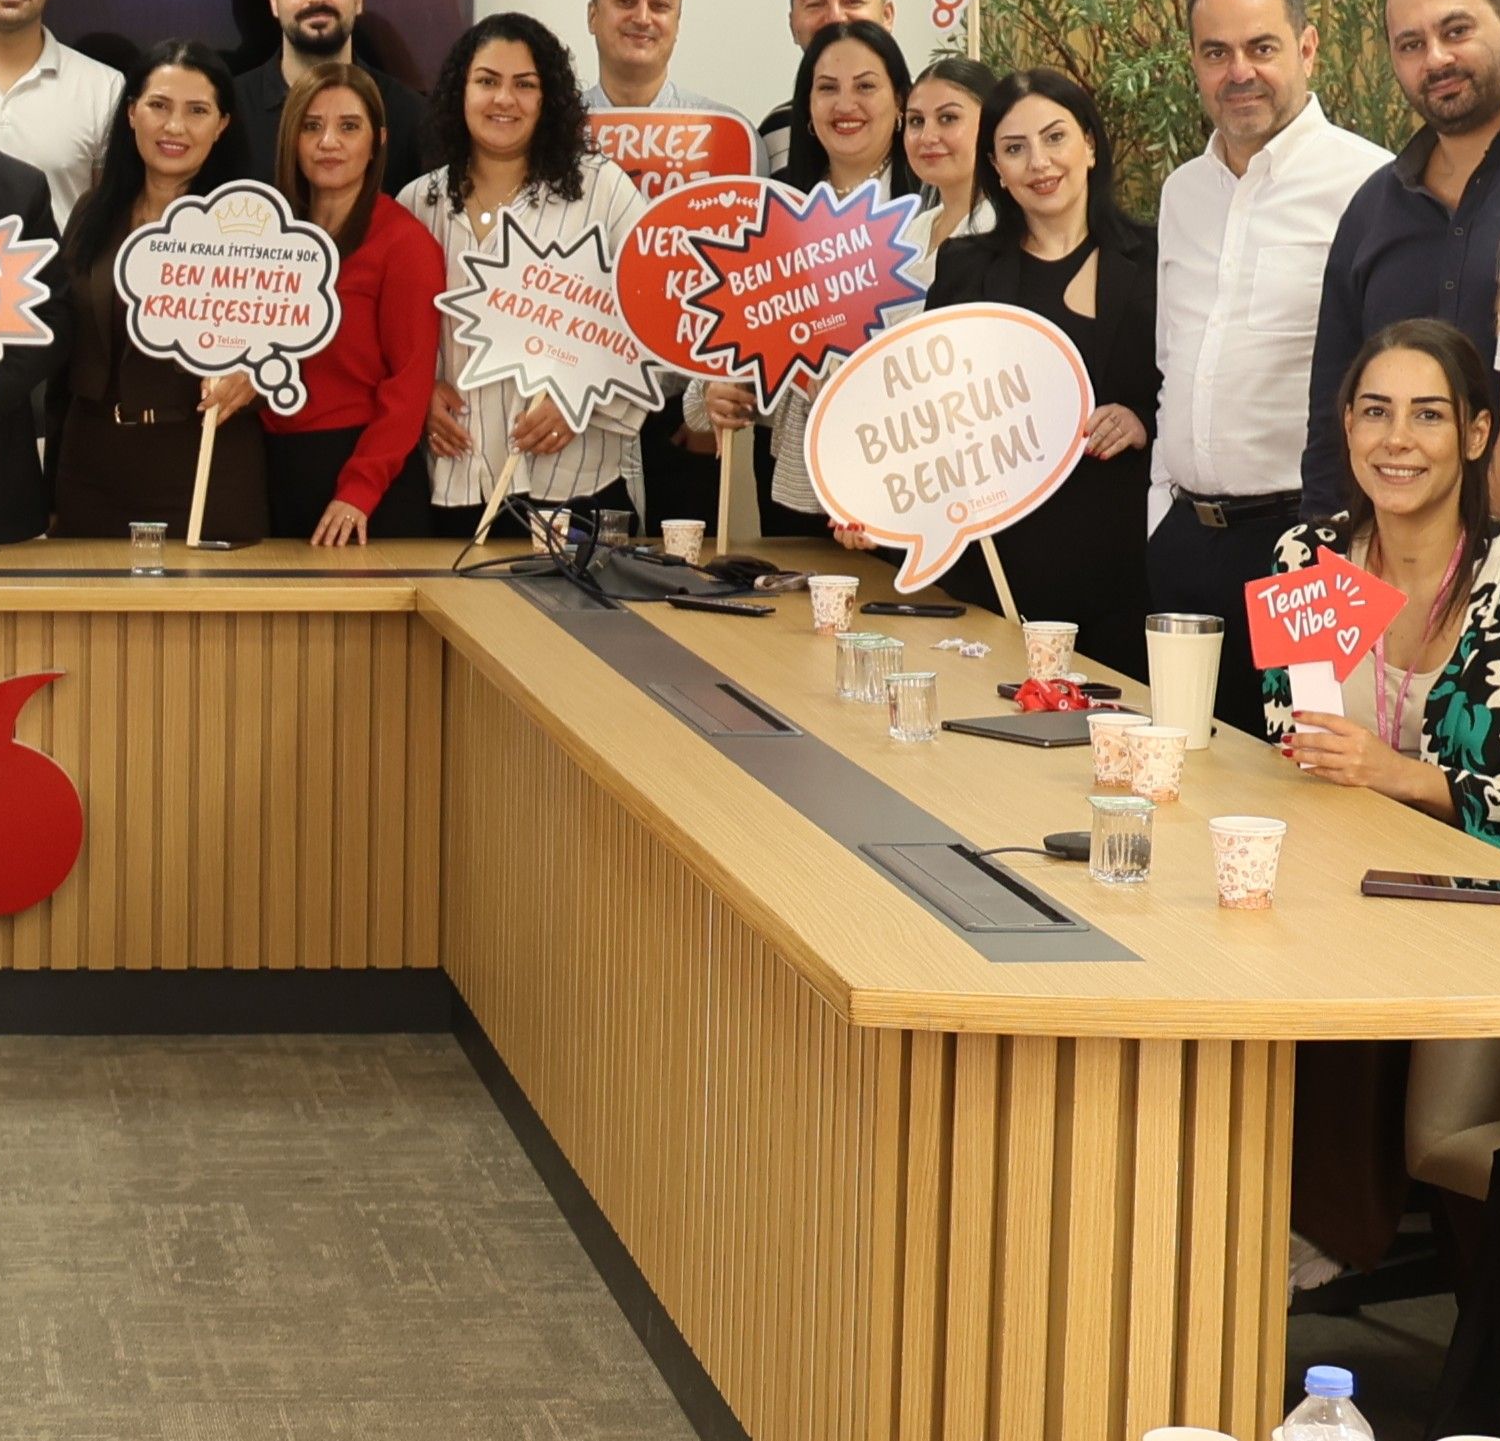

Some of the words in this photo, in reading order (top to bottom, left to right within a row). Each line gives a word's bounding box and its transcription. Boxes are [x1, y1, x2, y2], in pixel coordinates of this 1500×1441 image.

[150, 239, 187, 254] BENİM
[190, 242, 225, 257] KRALA
[228, 242, 293, 261] İHTİYACIM
[297, 250, 319, 263] YOK
[636, 225, 691, 258] VER
[728, 259, 772, 296] BEN
[777, 224, 872, 278] VARSAM
[160, 262, 205, 287] BEN
[211, 265, 301, 294] MH'NİN
[522, 263, 618, 317] ÇÖZÜMÜ
[744, 283, 820, 329] SORUN
[824, 258, 879, 302] YOK!
[143, 292, 311, 327] KRALİÇESİYİM
[486, 287, 564, 331] KADAR
[565, 317, 640, 365] KONUŞ
[810, 313, 846, 331] Telsim
[217, 335, 246, 346] Telsim
[883, 334, 973, 399] ALO,
[855, 363, 1031, 464] BUYRUN
[883, 415, 1045, 514] BENİM!
[1257, 578, 1329, 619] Team
[1283, 605, 1337, 643] Vibe
